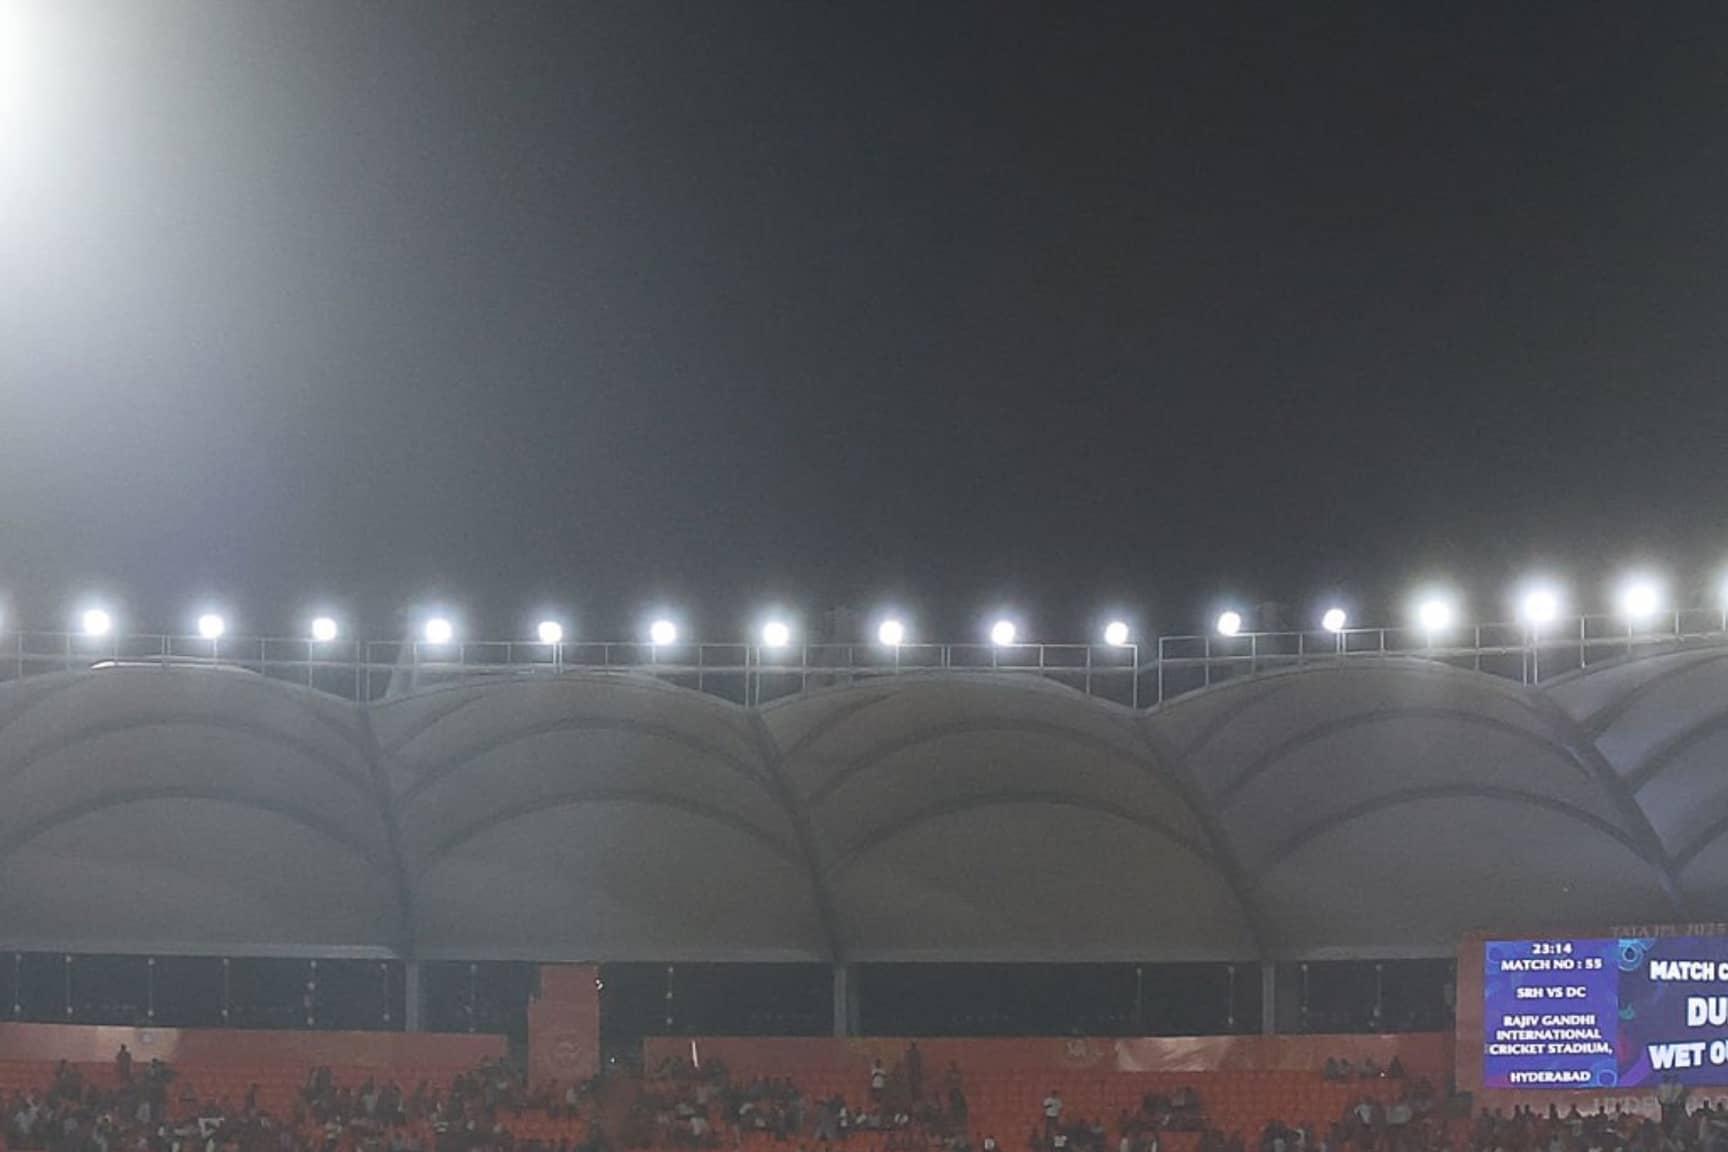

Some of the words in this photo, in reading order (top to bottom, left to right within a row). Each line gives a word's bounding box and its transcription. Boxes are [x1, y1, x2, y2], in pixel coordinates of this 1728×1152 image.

[1532, 943, 1572, 954] 23:14
[1501, 960, 1551, 971] MATCH
[1554, 959, 1575, 969] NO
[1585, 958, 1602, 969] 55
[1650, 960, 1715, 980] MATCH
[1517, 987, 1544, 998] SRH
[1546, 987, 1563, 998] VS
[1566, 987, 1586, 997] DC
[1503, 1015, 1539, 1028] RAJIV
[1541, 1015, 1595, 1026] GANDHI
[1496, 1029, 1602, 1040] INTERNATIONAL
[1489, 1044, 1545, 1055] CRICKET
[1548, 1042, 1613, 1055] STADIUM,
[1648, 1042, 1706, 1070] WET
[1510, 1071, 1591, 1082] HYDERABAD
